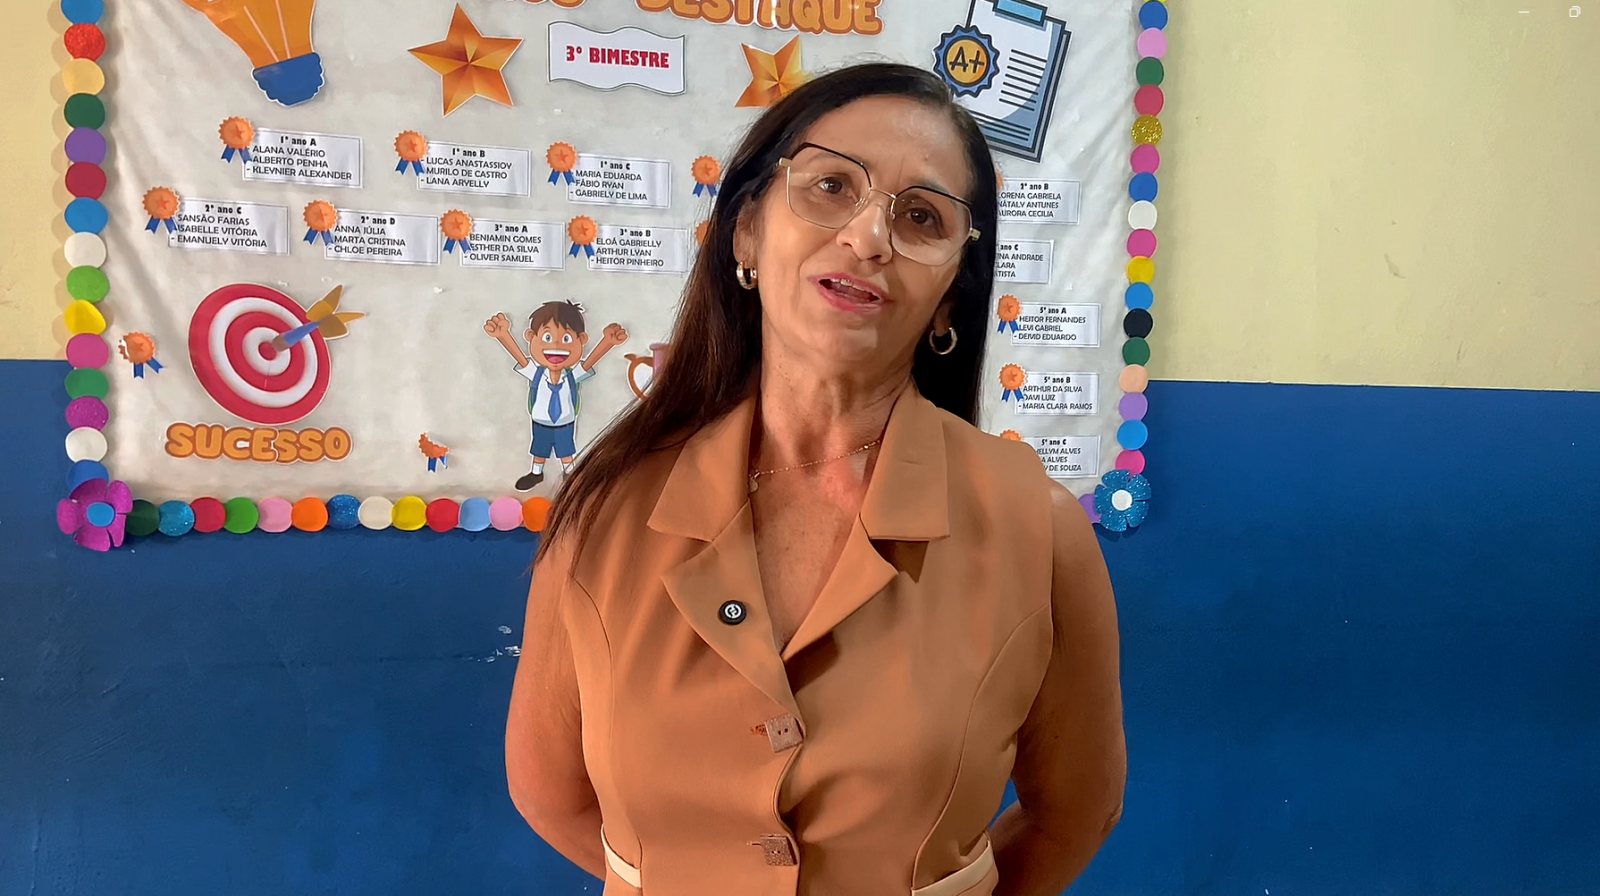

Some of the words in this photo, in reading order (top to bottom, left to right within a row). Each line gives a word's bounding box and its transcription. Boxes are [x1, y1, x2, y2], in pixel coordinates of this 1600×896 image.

[589, 47, 669, 68] BIMESTRE
[949, 46, 985, 74] A+
[291, 137, 307, 145] ano
[309, 138, 317, 146] A
[252, 145, 284, 154] ALANA
[287, 147, 326, 157] VALÉRIO
[462, 149, 477, 157] ano
[479, 150, 486, 158] B
[252, 155, 294, 166] ALBERTO
[297, 158, 328, 168] PENHA
[426, 157, 454, 165] LUCAS
[610, 162, 623, 170] ano
[625, 162, 631, 171] C
[252, 166, 296, 176] KLEYNIER
[298, 169, 352, 180] ALEXANDER
[426, 167, 459, 176] MURILO
[461, 168, 472, 178] DE
[474, 170, 508, 179] CASTRO
[575, 169, 602, 178] MARIA
[603, 171, 642, 181] EDUARDA
[426, 177, 450, 185] LANA
[452, 179, 490, 188] ARYELLY
[575, 178, 600, 188] FÁBIO
[602, 181, 624, 190] RYAN
[575, 189, 614, 199] GABRIELY
[615, 191, 626, 200] DE
[628, 192, 648, 201] LIMA
[1027, 192, 1062, 200] GABRIELA
[217, 206, 233, 214] ano
[236, 206, 242, 214] C
[1026, 201, 1059, 209] ANTUNES
[177, 214, 215, 223] SANSÃO
[217, 216, 250, 226] FARIAS
[372, 217, 387, 225] ano
[389, 217, 396, 225] D
[221, 226, 258, 237] VITÓRIA
[334, 225, 361, 234] ANNA
[363, 225, 386, 236] JÚLIA
[521, 225, 528, 233] A
[629, 229, 643, 237] ano
[177, 235, 229, 245] EMANUELY
[230, 237, 267, 247] VITÓRIA
[334, 235, 365, 244] MARTA
[367, 237, 406, 247] CRISTINA
[469, 233, 511, 243] BENJAMIN
[513, 235, 542, 244] GOMES
[596, 237, 618, 246] ELOÁ
[619, 238, 662, 248] GABRIELLY
[366, 247, 403, 256] PEREIRA
[502, 244, 514, 253] DA
[516, 245, 540, 253] SILVA
[596, 247, 629, 256] ARTHUR
[630, 248, 651, 257] LYAN
[469, 253, 500, 262] OLIVER
[501, 254, 534, 263] SAMUEL
[596, 257, 625, 265] HEITOR
[626, 258, 664, 267] PINHEIRO
[1011, 253, 1044, 261] ANDRADE
[1019, 315, 1044, 323] HEITOR
[1045, 316, 1086, 324] FERNANDES
[1034, 324, 1063, 332] GABRIEL
[1042, 333, 1077, 341] EDUARDO
[1022, 385, 1051, 393] ARTHUR
[1052, 385, 1063, 393] DA
[1022, 402, 1045, 410] MARIA
[165, 422, 352, 464] SUCESSO
[1060, 447, 1081, 455] ALVES
